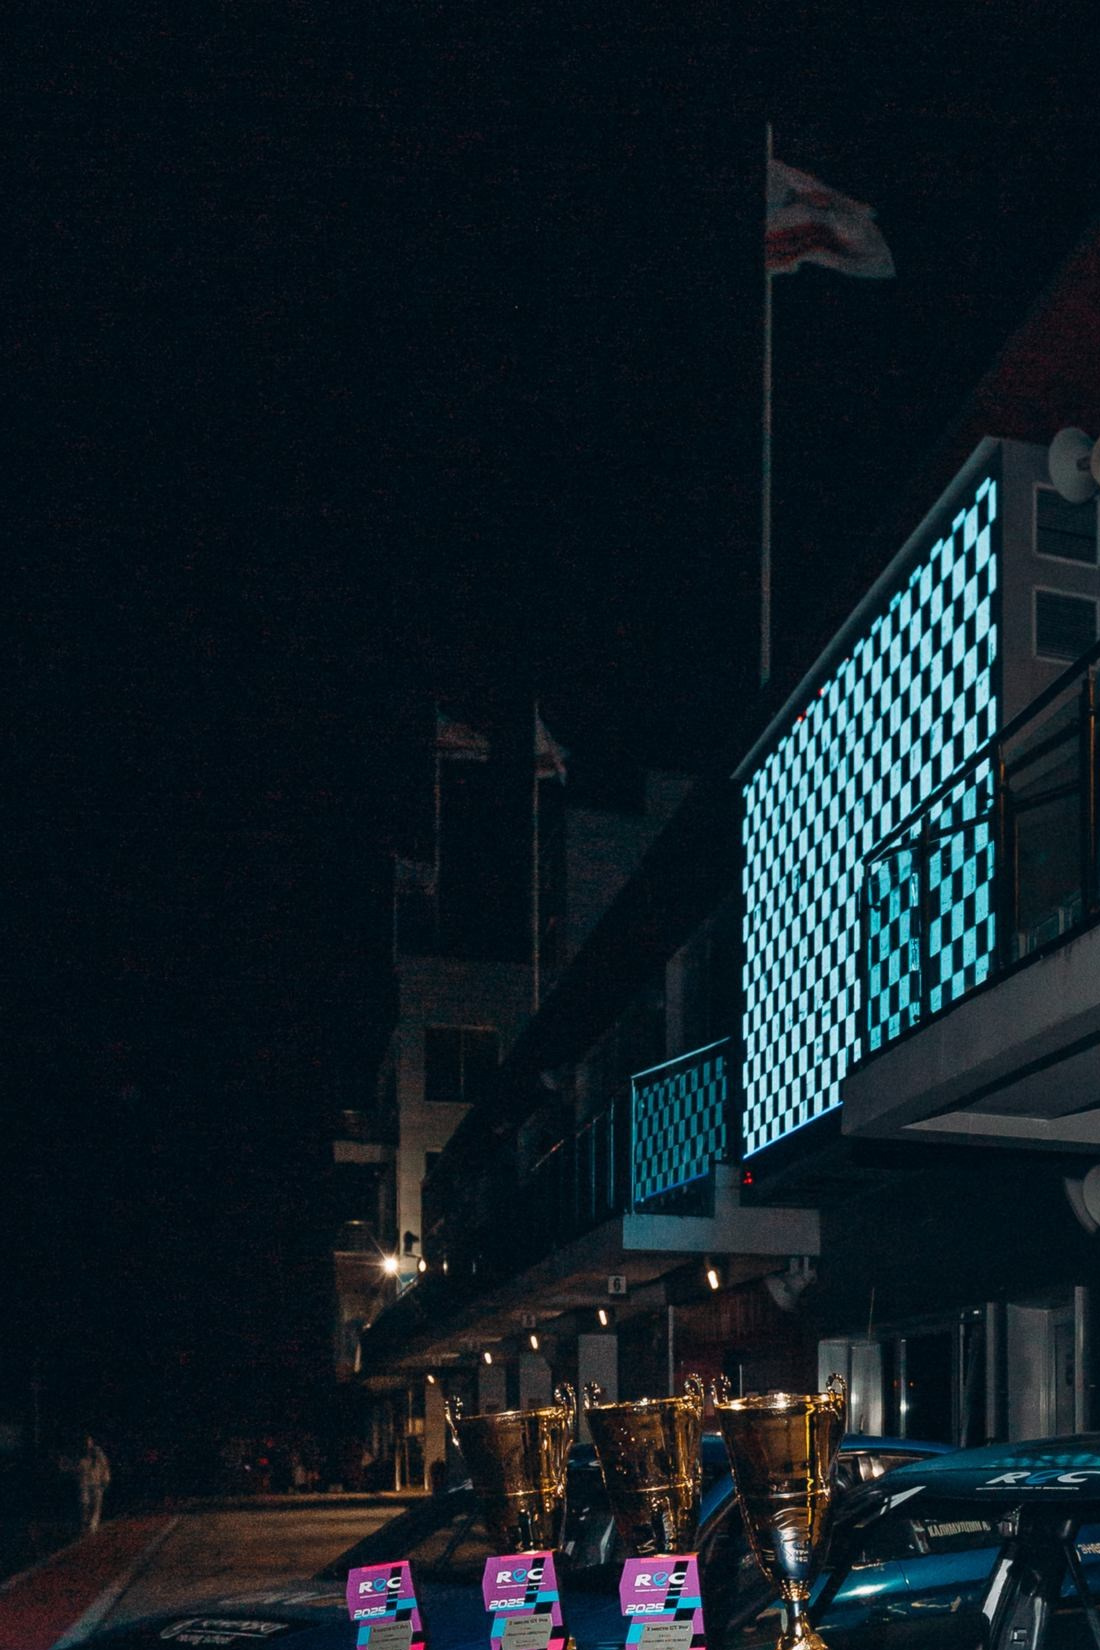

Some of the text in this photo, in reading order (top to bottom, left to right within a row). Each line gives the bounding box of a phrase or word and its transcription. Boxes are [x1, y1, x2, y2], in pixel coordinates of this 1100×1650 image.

[489, 1598, 526, 1611] 2025
[625, 1602, 665, 1615] 2025
[354, 1605, 387, 1620] 2025
